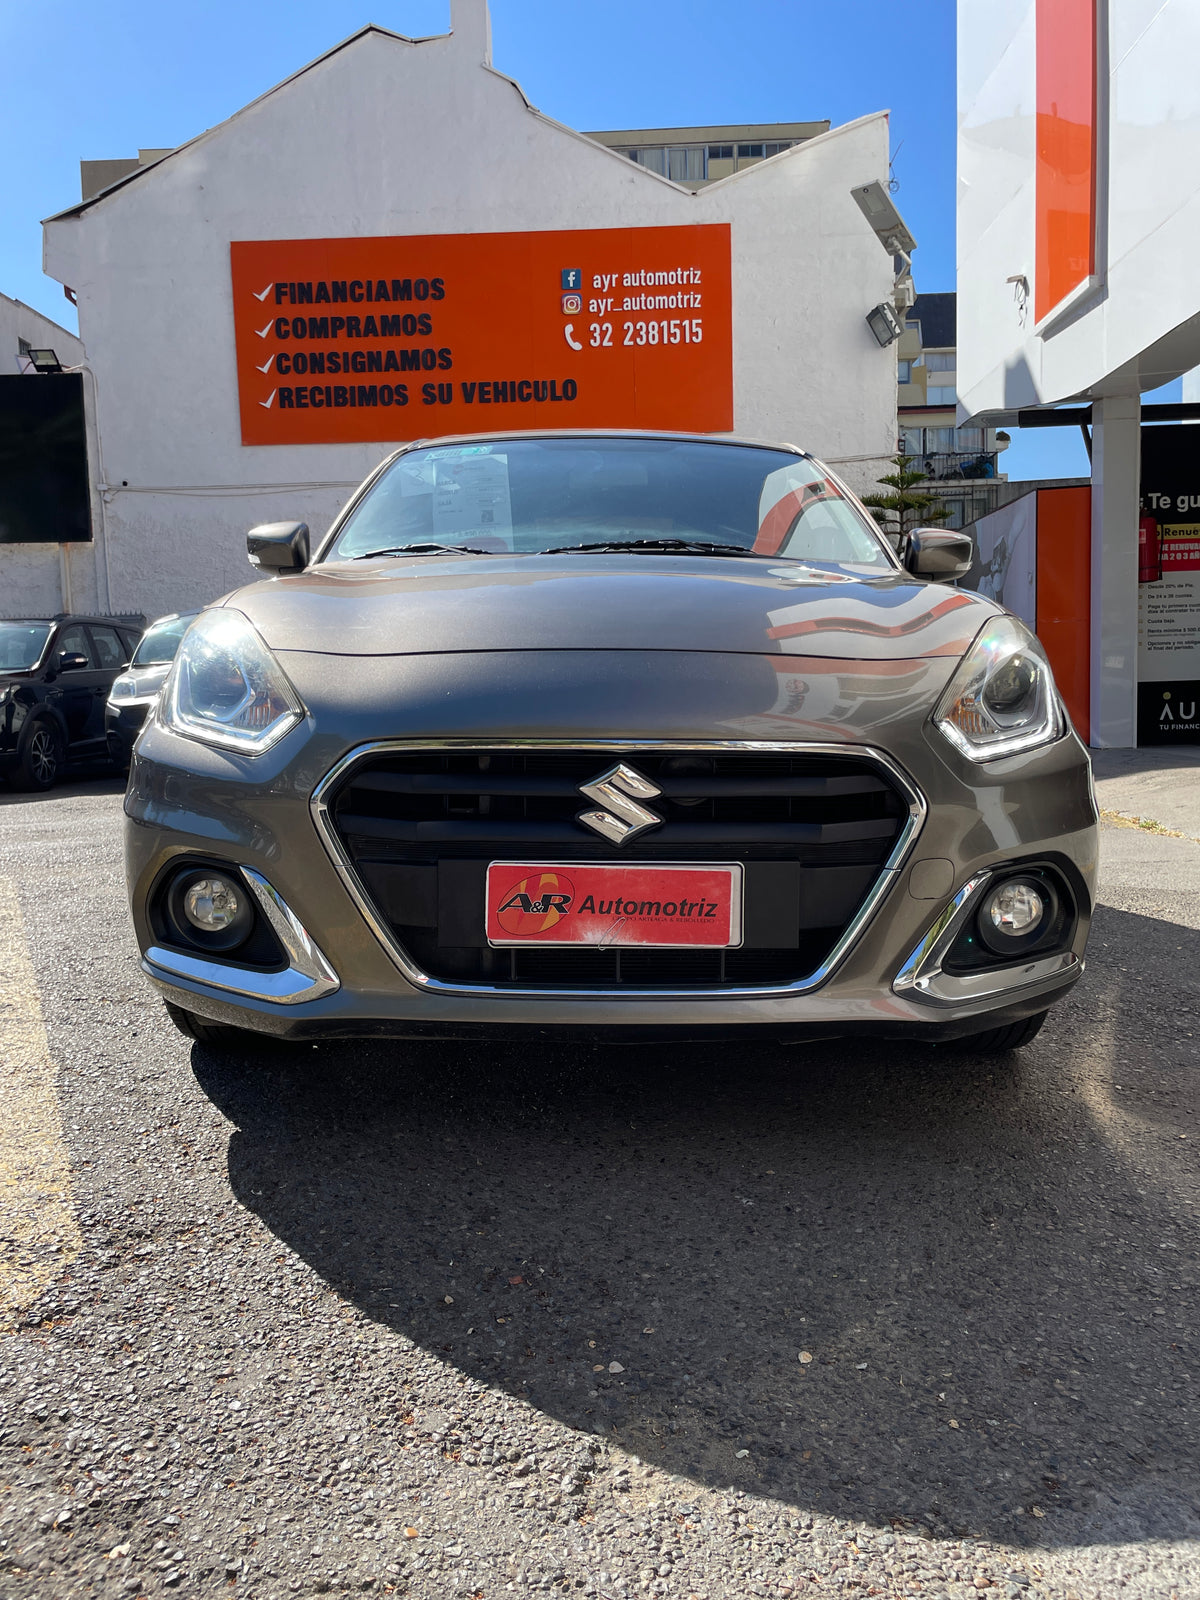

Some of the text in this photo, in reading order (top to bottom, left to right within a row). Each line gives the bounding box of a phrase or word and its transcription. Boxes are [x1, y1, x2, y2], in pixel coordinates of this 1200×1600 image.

[274, 277, 446, 306] FINANCIAMOS
[593, 267, 702, 291] ayr automotriz
[588, 291, 702, 314] ayr_automotriz
[274, 313, 433, 341] COMPRAMOS
[589, 319, 703, 347] 32 2381515
[275, 348, 453, 376] CONSIGNAMOS
[279, 378, 578, 409] RECIBIMOS SU VEHICULO
[496, 892, 719, 919] A&R Automotriz
